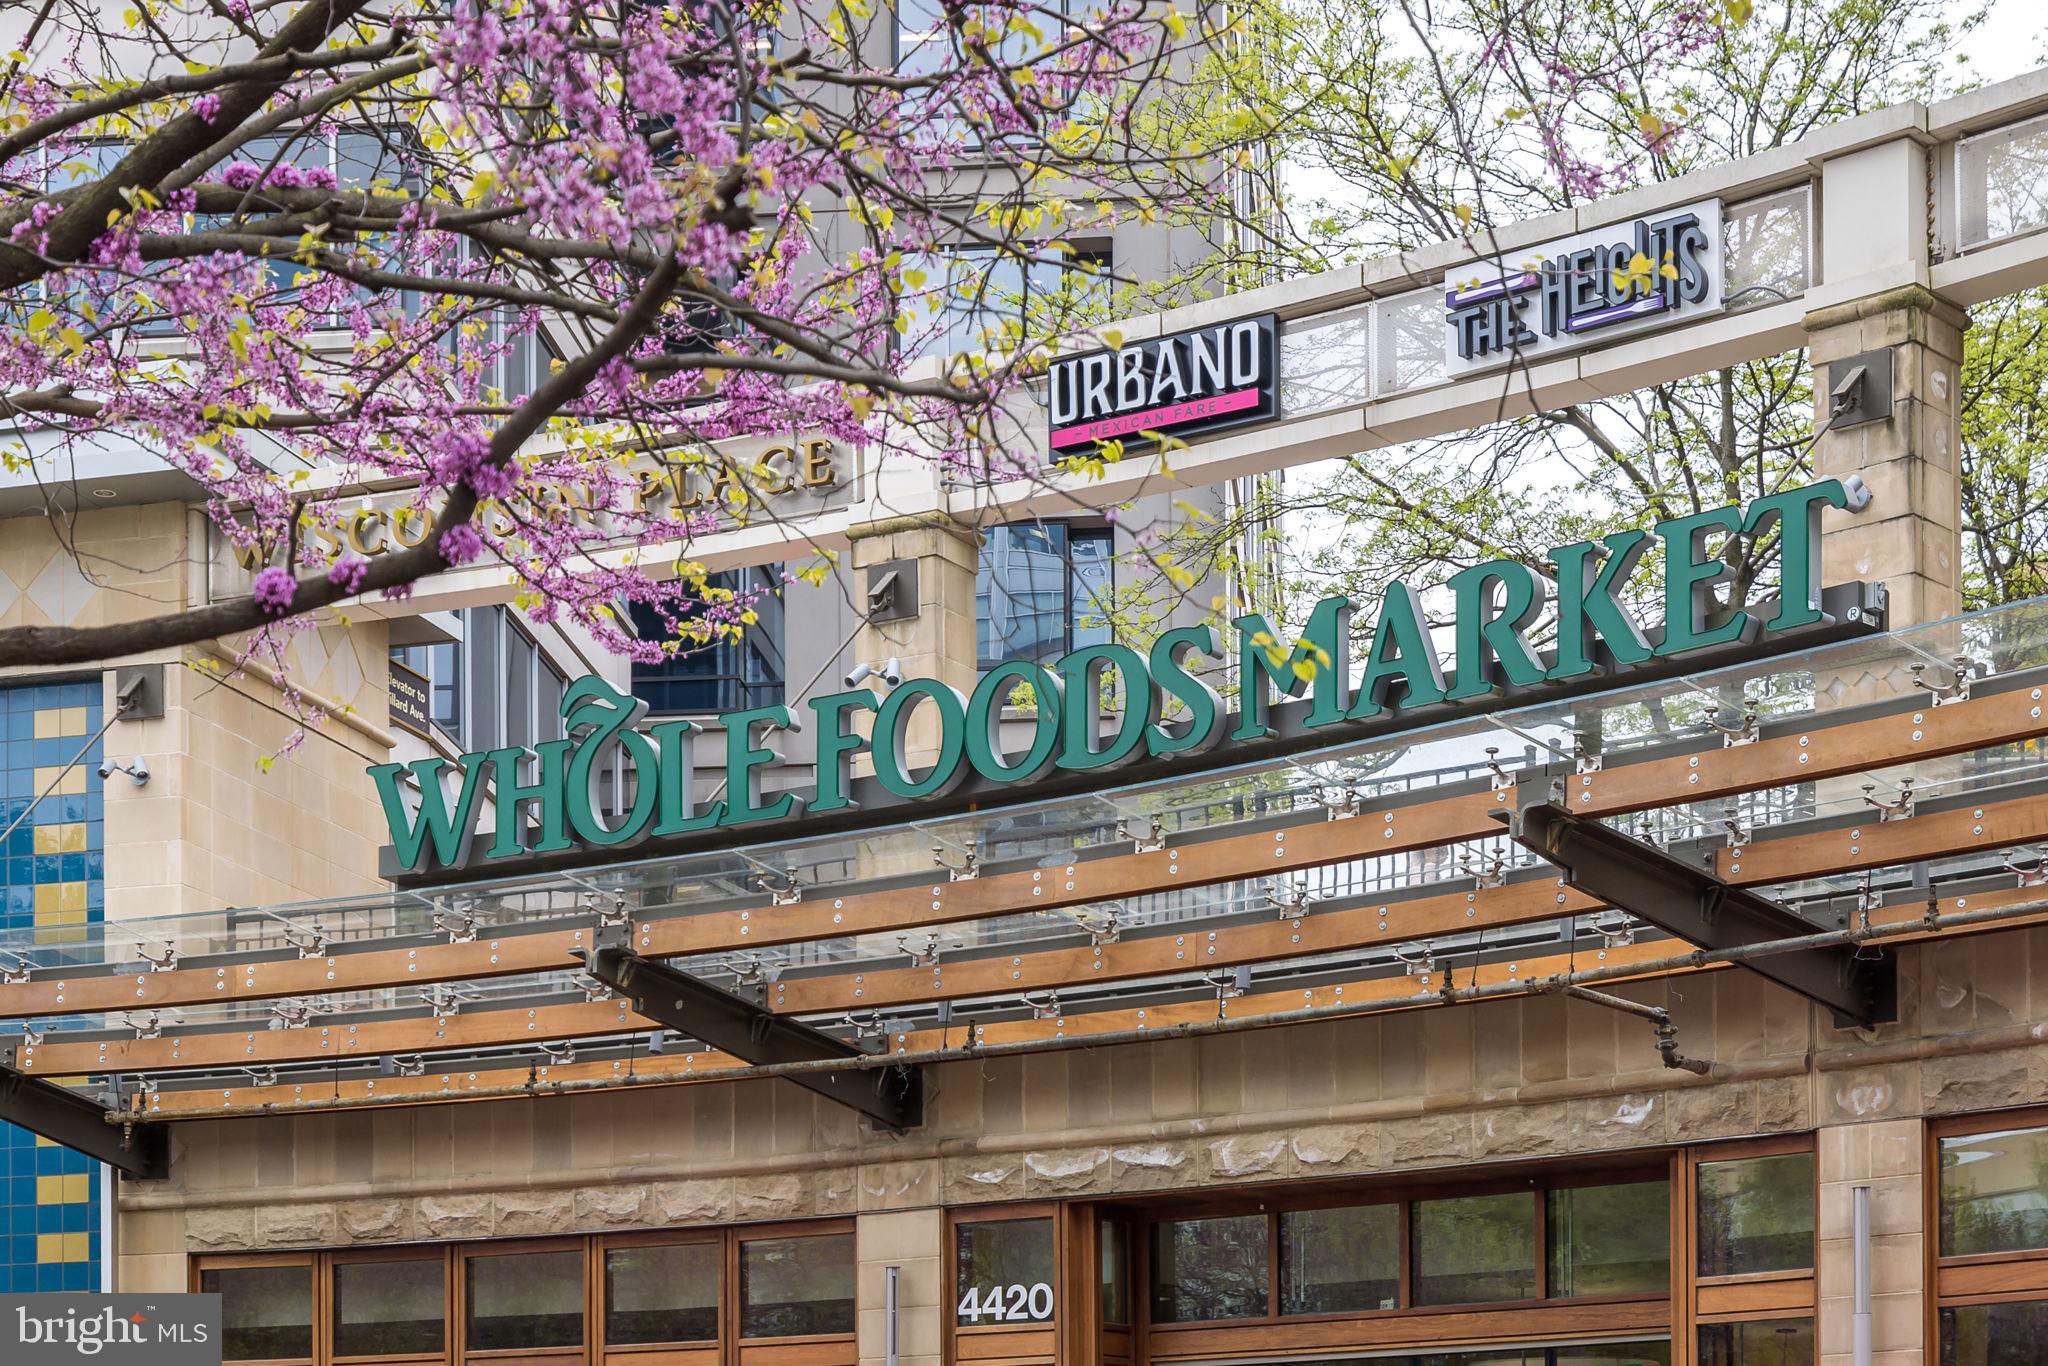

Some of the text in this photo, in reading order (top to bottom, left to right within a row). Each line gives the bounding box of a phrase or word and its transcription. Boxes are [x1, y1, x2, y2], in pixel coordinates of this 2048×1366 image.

[1446, 213, 1708, 359] THE HEIGHTS
[1050, 321, 1260, 425] URBANO
[1089, 401, 1217, 437] MEXICAN FARE
[630, 438, 835, 514] PLACE
[366, 478, 1851, 871] WHOLE FOODS MARKET
[389, 672, 426, 703] levator to
[389, 692, 426, 723] illard Ave.
[958, 1282, 1054, 1322] 4420
